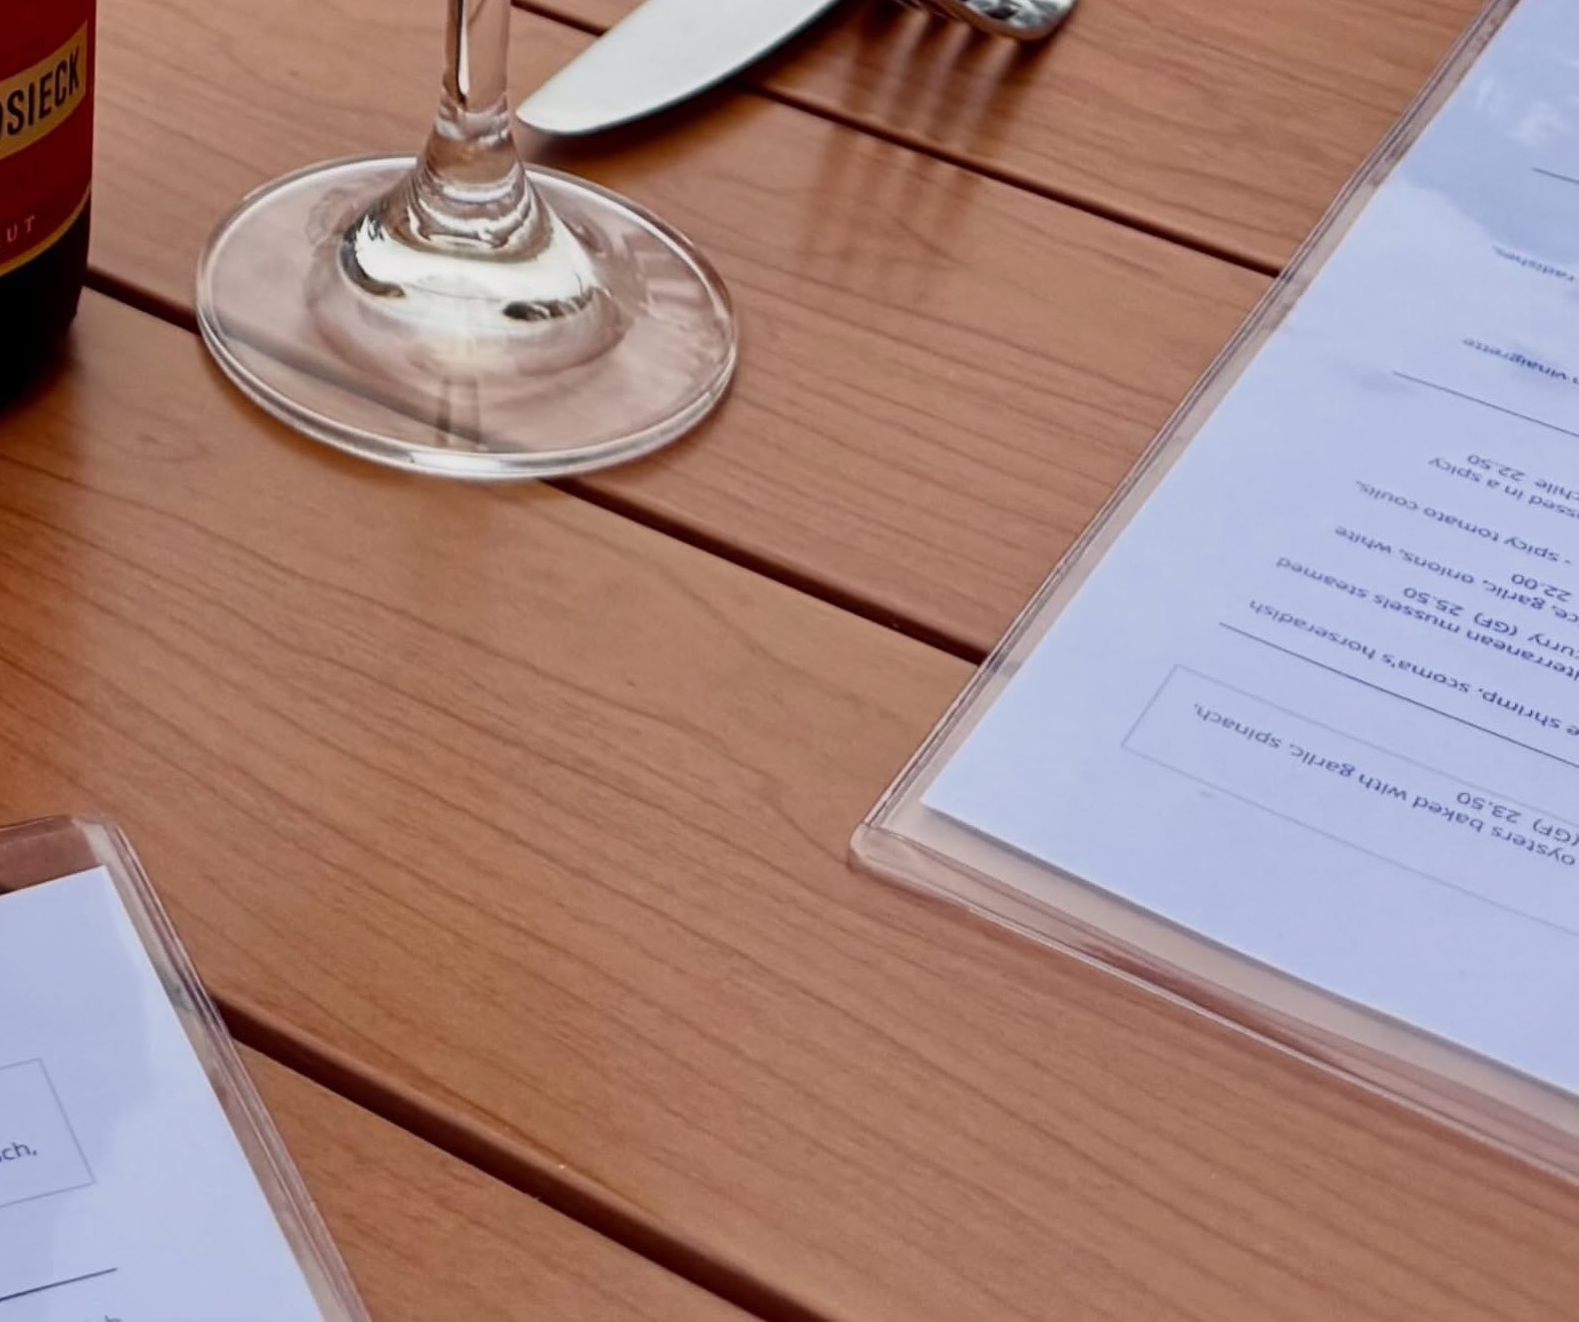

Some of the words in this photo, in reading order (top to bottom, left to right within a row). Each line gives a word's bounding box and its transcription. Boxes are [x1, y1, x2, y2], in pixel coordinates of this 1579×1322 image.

[1462, 338, 1566, 382] vinaigrette
[1427, 456, 1483, 484] spicy
[1467, 454, 1526, 482] 22.50
[1486, 478, 1499, 489] a
[1504, 485, 1523, 501] in
[1334, 526, 1392, 557] white
[1422, 507, 1499, 544] tomato
[1399, 549, 1475, 585] onions,
[1503, 536, 1560, 564] spicy
[1275, 556, 1368, 600] steamed
[1510, 573, 1572, 603] 22.00
[1402, 586, 1464, 616] 25.50
[1482, 580, 1546, 611] garlic,
[1248, 599, 1376, 660] horseradish
[1373, 593, 1461, 635] mussels
[1472, 611, 1518, 638] (GF)
[1381, 654, 1471, 696] scoma's
[1191, 703, 1282, 751] spinach,
[1477, 687, 1562, 733] shrimp,
[1288, 743, 1356, 779] garlic,
[1357, 772, 1408, 805] with
[1412, 794, 1484, 833] baked
[1455, 790, 1522, 824] 23.50
[1490, 826, 1576, 868] oysters
[1531, 818, 1579, 847] (GF)
